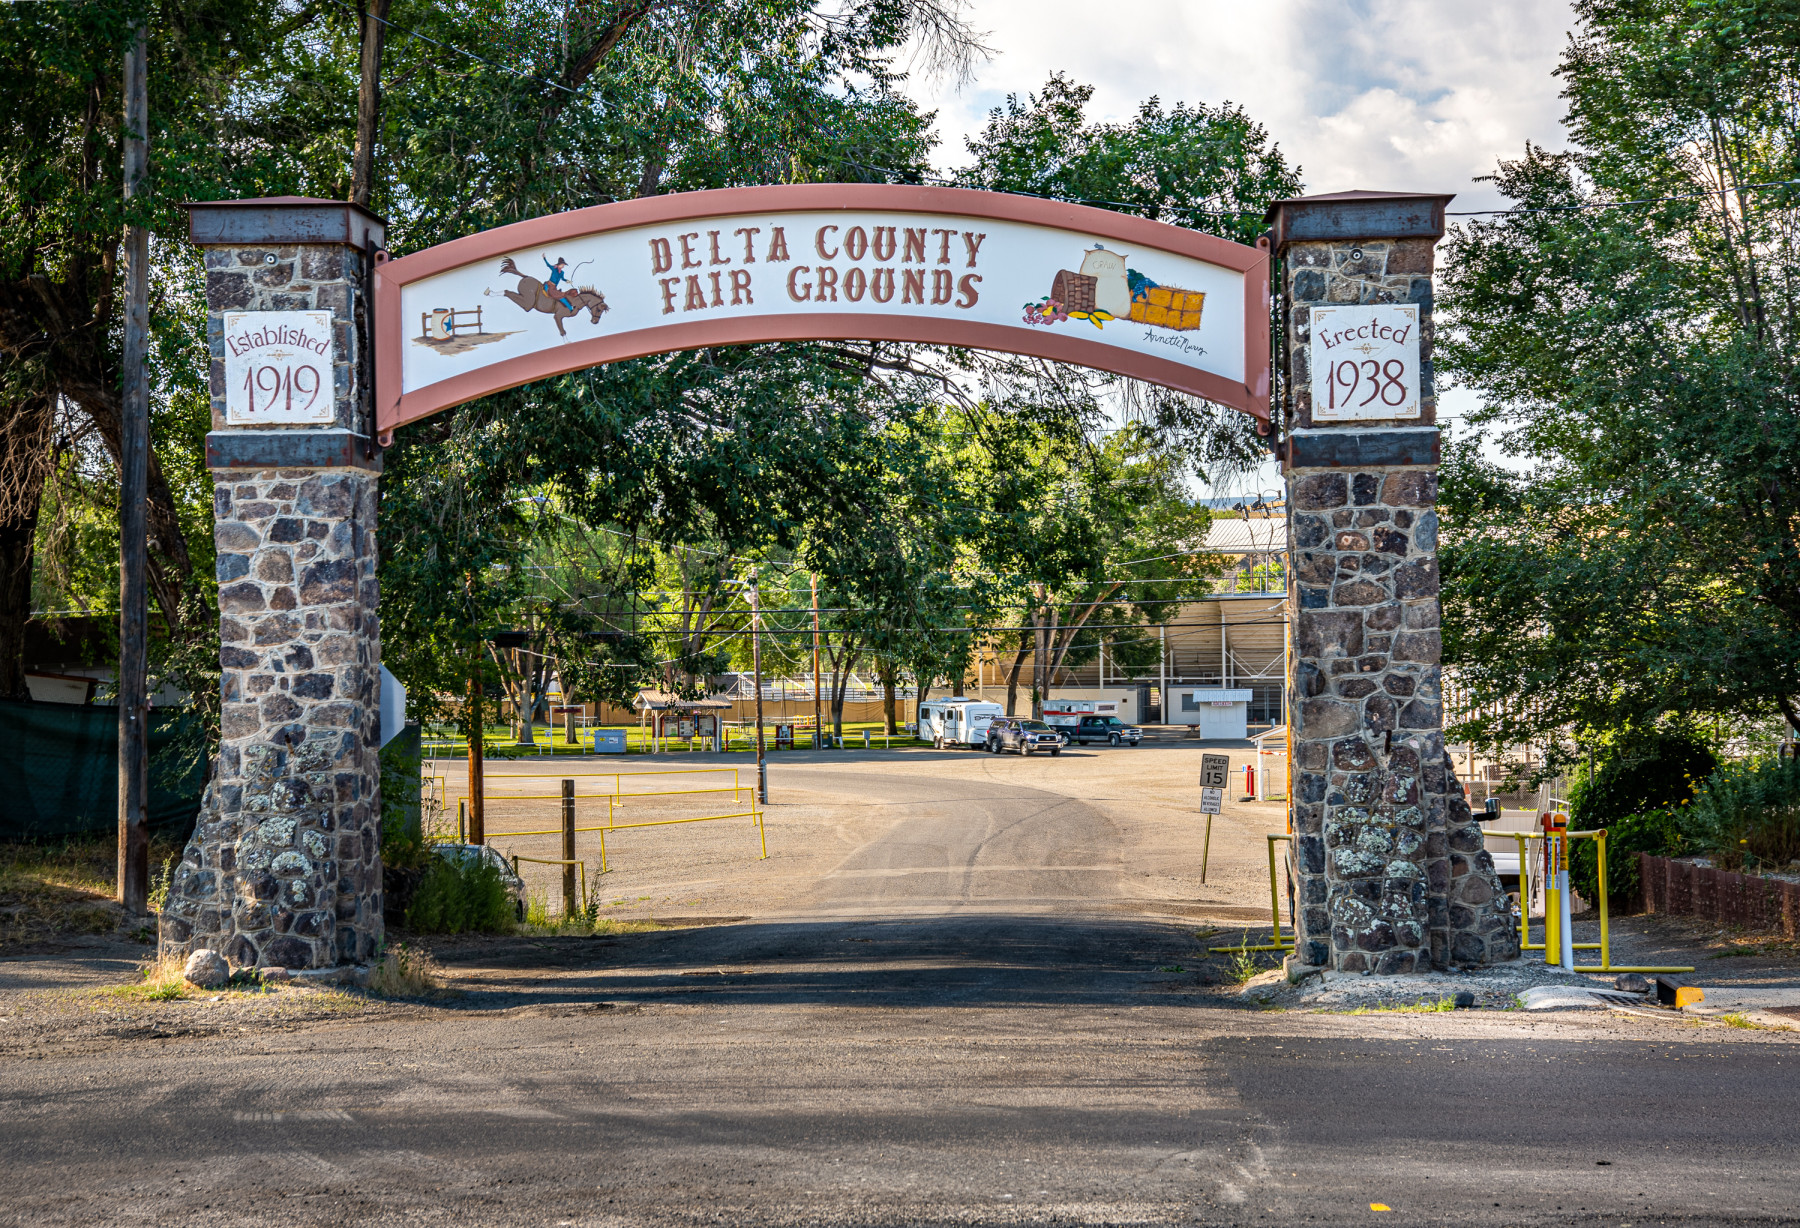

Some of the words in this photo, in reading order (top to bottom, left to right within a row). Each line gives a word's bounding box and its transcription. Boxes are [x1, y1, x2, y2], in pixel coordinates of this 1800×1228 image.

[648, 226, 790, 276] DELTA
[814, 225, 986, 268] COUNTY
[658, 269, 754, 315] FAIR
[786, 265, 983, 309] GROUNDS
[226, 324, 331, 358] Established
[1318, 317, 1412, 350] Erected
[243, 365, 320, 412] 1919
[1326, 359, 1407, 409] 1938
[1204, 757, 1227, 765] SPEED
[1206, 772, 1223, 784] 15
